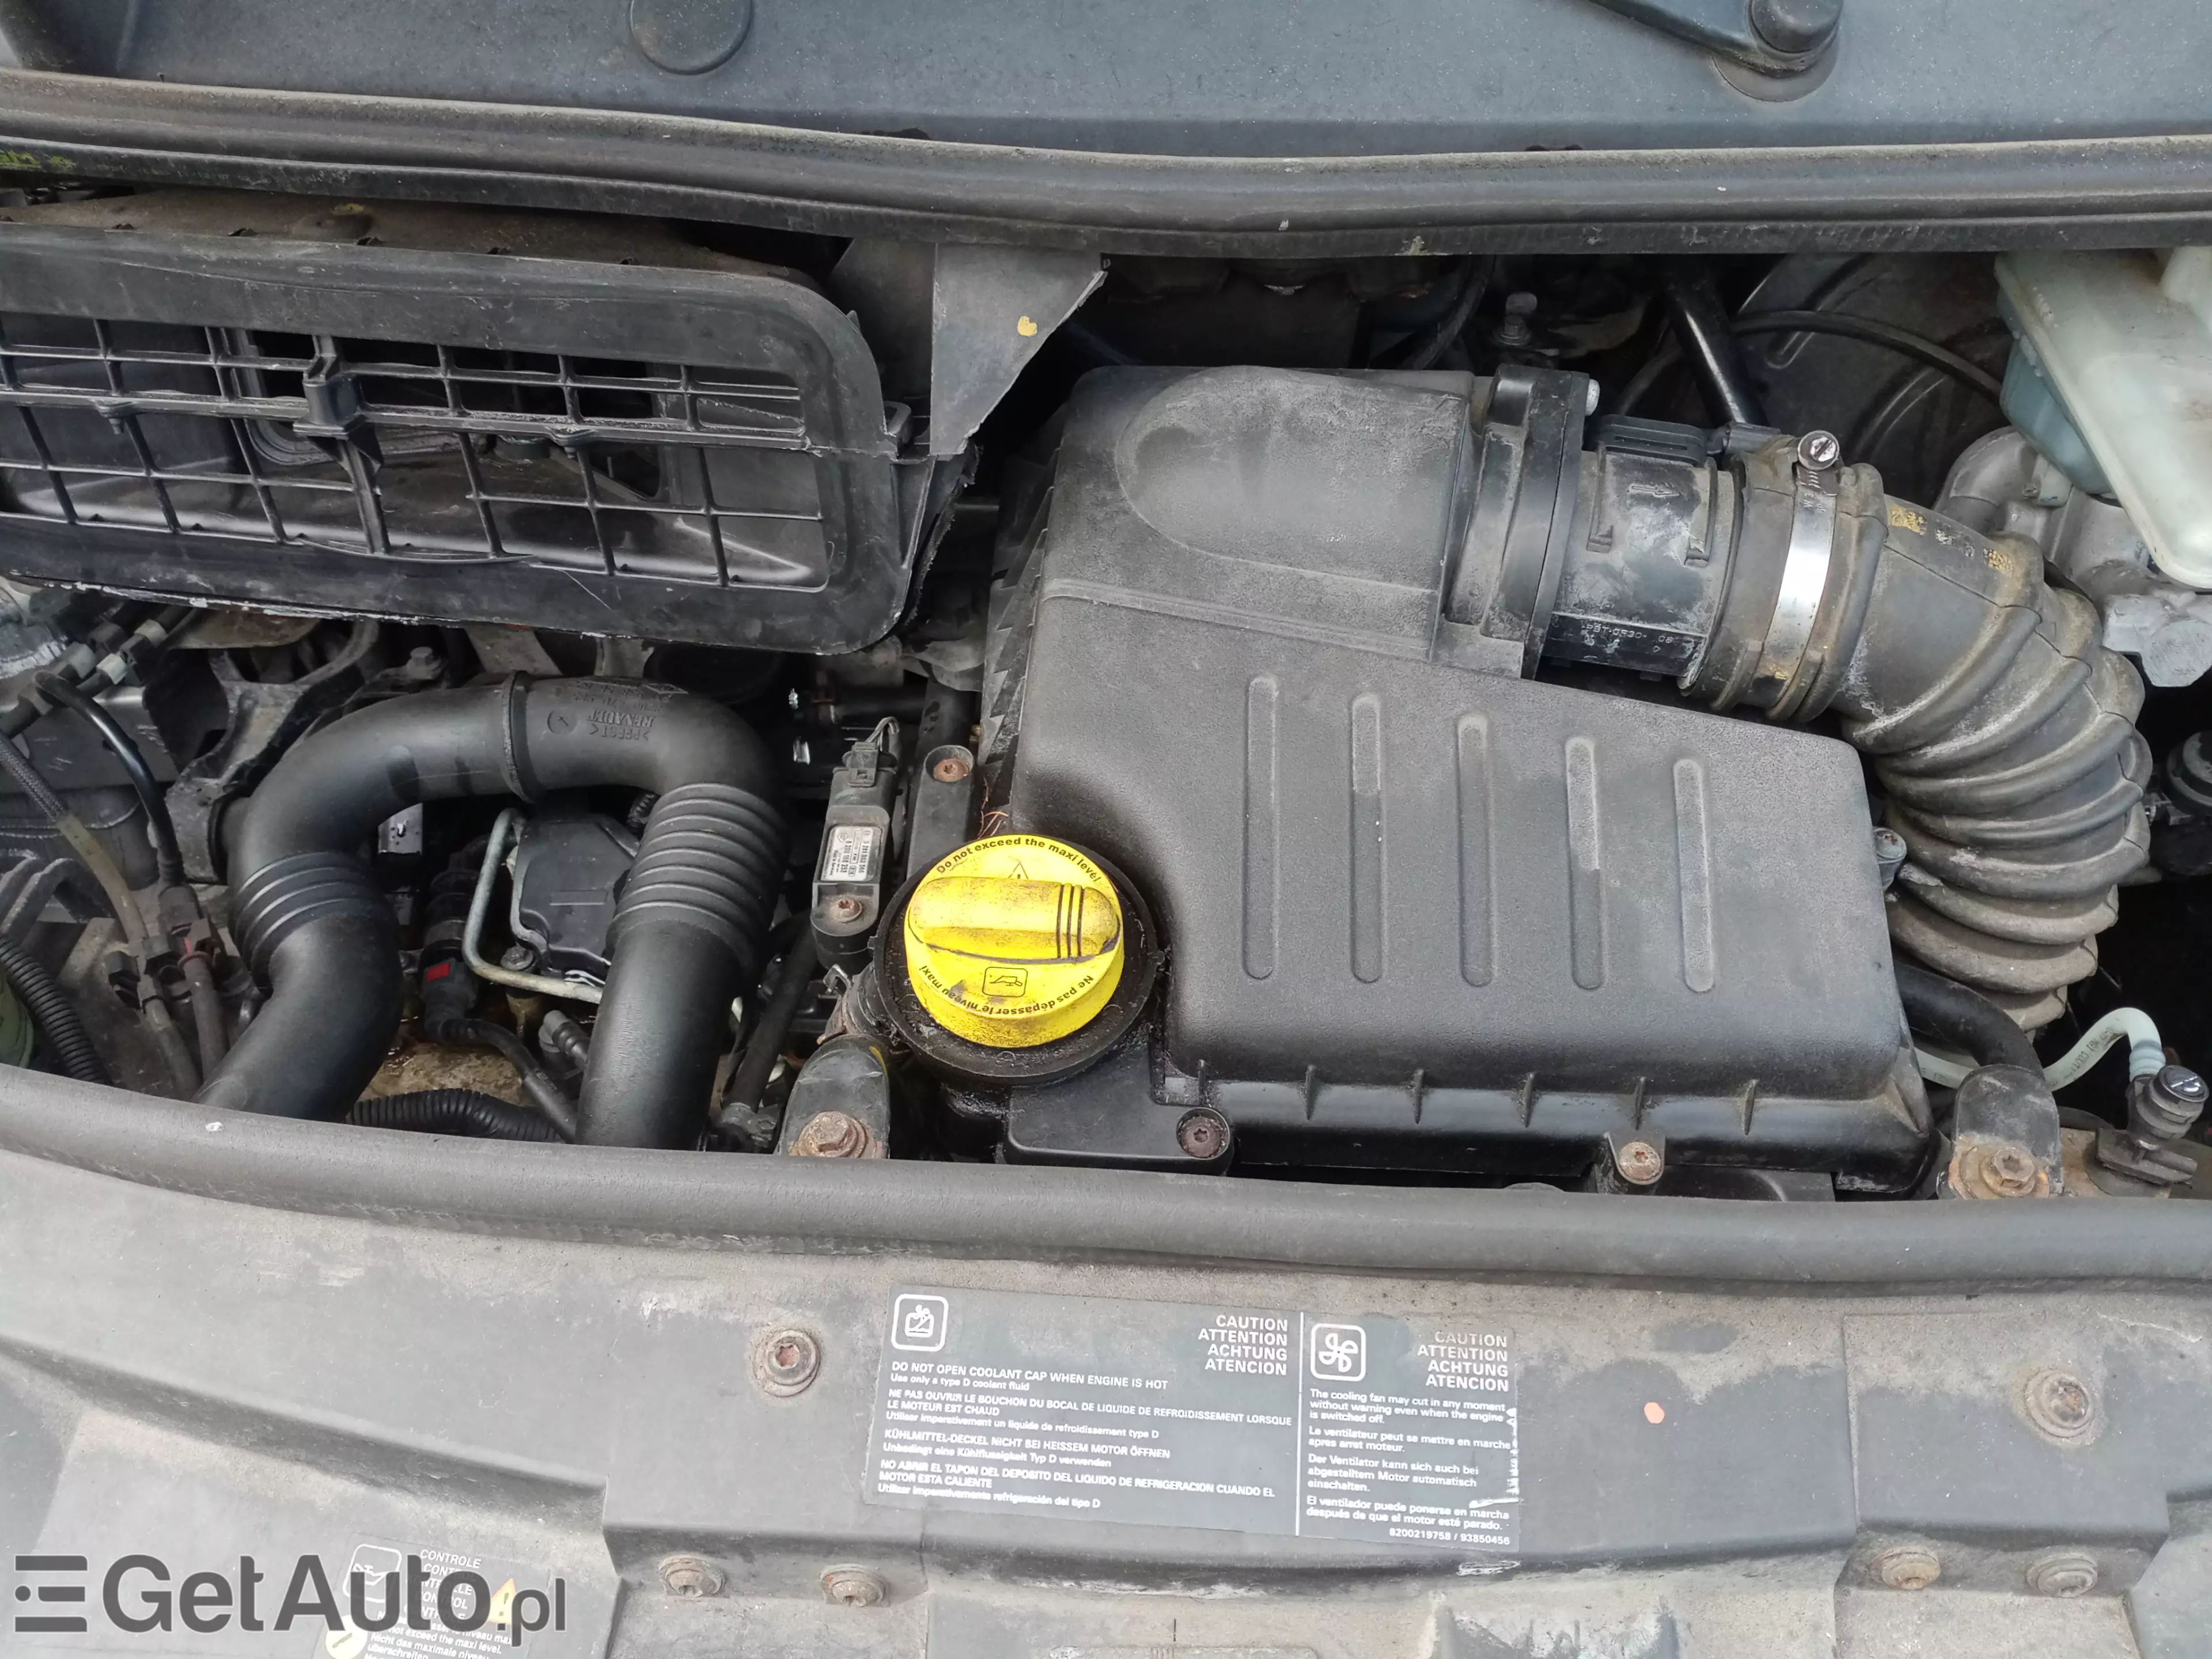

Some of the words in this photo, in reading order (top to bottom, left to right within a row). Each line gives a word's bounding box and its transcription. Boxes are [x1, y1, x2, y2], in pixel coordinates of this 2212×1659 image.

[936, 861, 951, 874] Do
[953, 847, 973, 863] not
[974, 838, 1021, 852] exceed
[1025, 838, 1046, 848] the
[1048, 844, 1078, 862] maxi
[1077, 858, 1102, 882] level
[919, 965, 942, 990] maxi
[1078, 975, 1094, 988] Ne
[942, 987, 978, 1010] niveau
[1059, 987, 1077, 1003] pas
[982, 1006, 994, 1015] le
[996, 1000, 1055, 1016] dépasser
[1216, 1315, 1287, 1332] CAUTION
[1198, 1328, 1287, 1346] ATTENTION
[1435, 1331, 1507, 1348] CAUTION
[1208, 1344, 1287, 1361] ACHTUNG
[1418, 1344, 1508, 1362] ATTENTION
[892, 1361, 908, 1371] DO
[911, 1362, 934, 1372] NOT
[936, 1364, 966, 1375] OPEN
[969, 1366, 1022, 1378] COOLANT
[1024, 1370, 1047, 1380] CAP
[1050, 1373, 1084, 1383] WHEN
[1088, 1375, 1128, 1386] ENGINE
[1131, 1378, 1142, 1387] IS
[1145, 1380, 1168, 1389] HOT
[1205, 1358, 1287, 1376] ATENCION
[1428, 1360, 1508, 1377] ACHTUNG
[891, 1373, 908, 1382] Use
[910, 1375, 930, 1385] only
[940, 1378, 960, 1387] type
[963, 1377, 970, 1386] D
[972, 1380, 1006, 1388] coolant
[1008, 1381, 1029, 1390] fluid
[1426, 1374, 1509, 1392] ATENCION
[887, 1400, 899, 1408] LE
[901, 1401, 942, 1411] MOTEUR
[944, 1403, 963, 1412] EST
[964, 1405, 999, 1415] CHAUD
[888, 1388, 902, 1397] NE
[904, 1389, 923, 1399] PAS
[964, 1394, 976, 1403] LE
[978, 1395, 1027, 1406] BOUCHON
[1029, 1398, 1044, 1407] DU
[1046, 1400, 1078, 1410] BOCAL
[1081, 1402, 1094, 1411] DE
[1097, 1404, 1135, 1414] LIQUIDE
[1138, 1406, 1151, 1415] DE
[1153, 1408, 1244, 1421] REFROIDISSEMENT
[1247, 1415, 1291, 1425] LORSQUE
[1310, 1388, 1328, 1398] The
[1331, 1391, 1367, 1403] cooling
[1369, 1393, 1385, 1402] fan
[1388, 1396, 1409, 1406] may
[1430, 1398, 1440, 1406] in
[1442, 1400, 1460, 1410] any
[1463, 1402, 1505, 1412] moment
[1309, 1400, 1349, 1410] without
[1350, 1402, 1392, 1416] warning
[1420, 1408, 1448, 1417] when
[1450, 1410, 1467, 1419] the
[1469, 1412, 1503, 1422] engine
[1309, 1410, 1318, 1418] is
[1320, 1412, 1366, 1422] switched
[1309, 1426, 1321, 1435] Le
[1323, 1429, 1378, 1438] ventilateur
[1380, 1433, 1403, 1441] peut
[1421, 1436, 1455, 1445] mettre
[1473, 1440, 1510, 1449] marche
[1339, 1441, 1363, 1449] arret
[1366, 1442, 1404, 1451] moteur.
[1308, 1453, 1327, 1463] Der
[1330, 1456, 1379, 1467] Ventilator
[1382, 1459, 1407, 1469] kann
[1410, 1462, 1431, 1471] sich
[1463, 1465, 1478, 1474] bei
[1377, 1471, 1410, 1481] Motor
[1412, 1476, 1476, 1486] automatisch
[1306, 1495, 1316, 1505] El
[1319, 1498, 1372, 1508] ventilador
[1374, 1502, 1406, 1511] puede
[1409, 1505, 1451, 1514] ponerse
[1469, 1507, 1509, 1519] marcha
[1353, 1510, 1366, 1519] de
[1368, 1510, 1388, 1522] que
[1391, 1513, 1400, 1522] el
[1403, 1516, 1435, 1524] motor
[1389, 1528, 1450, 1540] 8200219758
[1460, 1533, 1510, 1544] 93850456
[420, 1549, 482, 1569] CONTROLE
[370, 1633, 395, 1645] Nicht
[396, 1638, 412, 1649] das
[414, 1642, 457, 1657] maximale
[406, 1627, 437, 1641] exceed
[439, 1634, 454, 1645] the
[454, 1638, 478, 1649] maxi
[479, 1641, 502, 1654] level.
